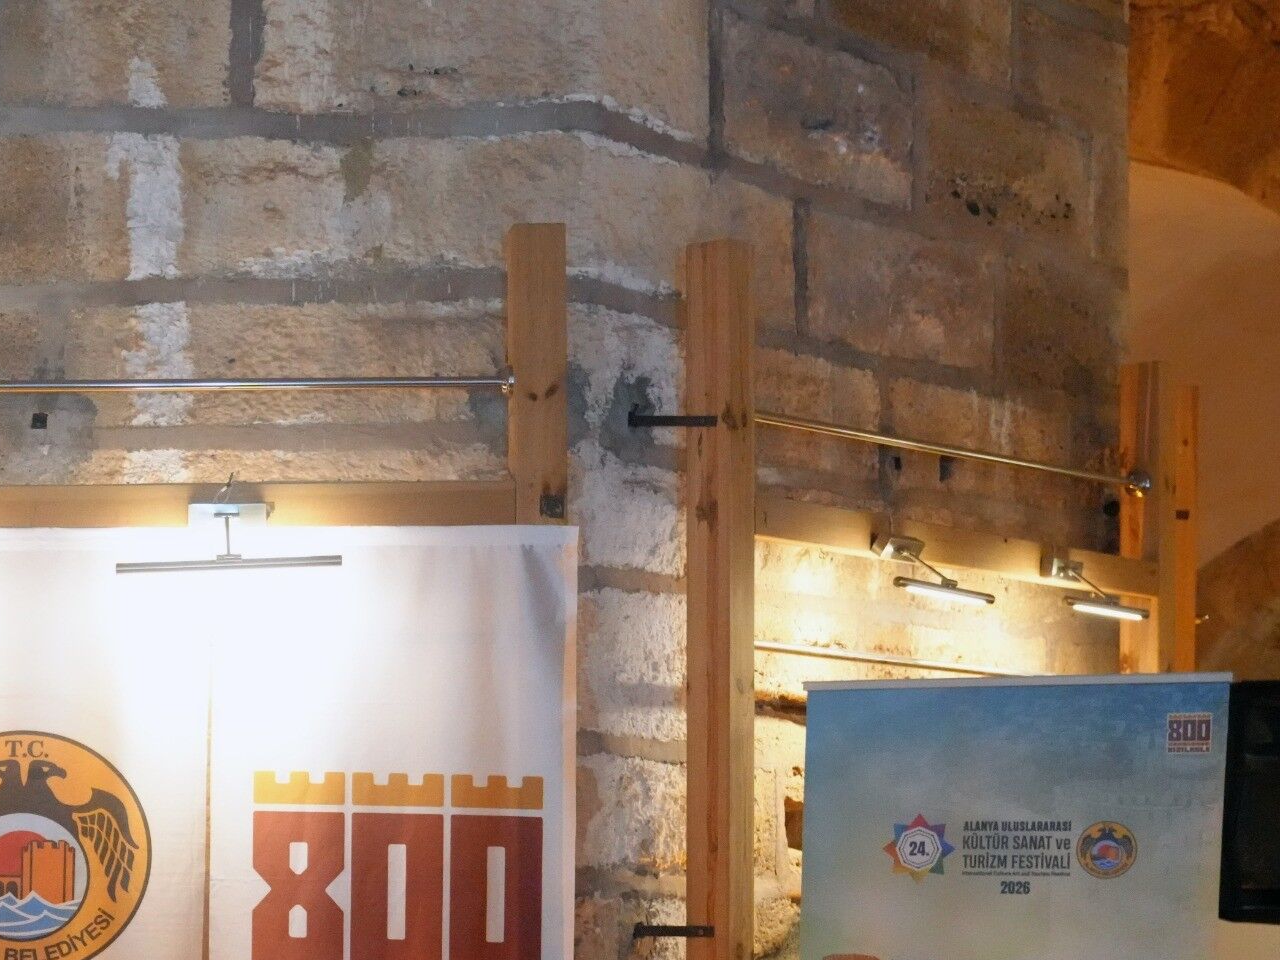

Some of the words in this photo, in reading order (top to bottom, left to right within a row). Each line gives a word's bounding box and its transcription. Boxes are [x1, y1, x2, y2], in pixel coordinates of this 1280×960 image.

[1168, 720, 1211, 741] 800
[4, 740, 49, 758] T.C.
[963, 821, 999, 832] ALANYA
[1001, 820, 1072, 832] ULUSLARARASI
[909, 841, 929, 856] 24.
[962, 832, 1009, 850] KÜLTÜR
[1012, 835, 1052, 850] SANAT
[1056, 837, 1071, 850] ve
[962, 853, 1007, 869] TURİZM
[1011, 852, 1071, 869] FESTİVALİ
[1000, 881, 1031, 895] 2026
